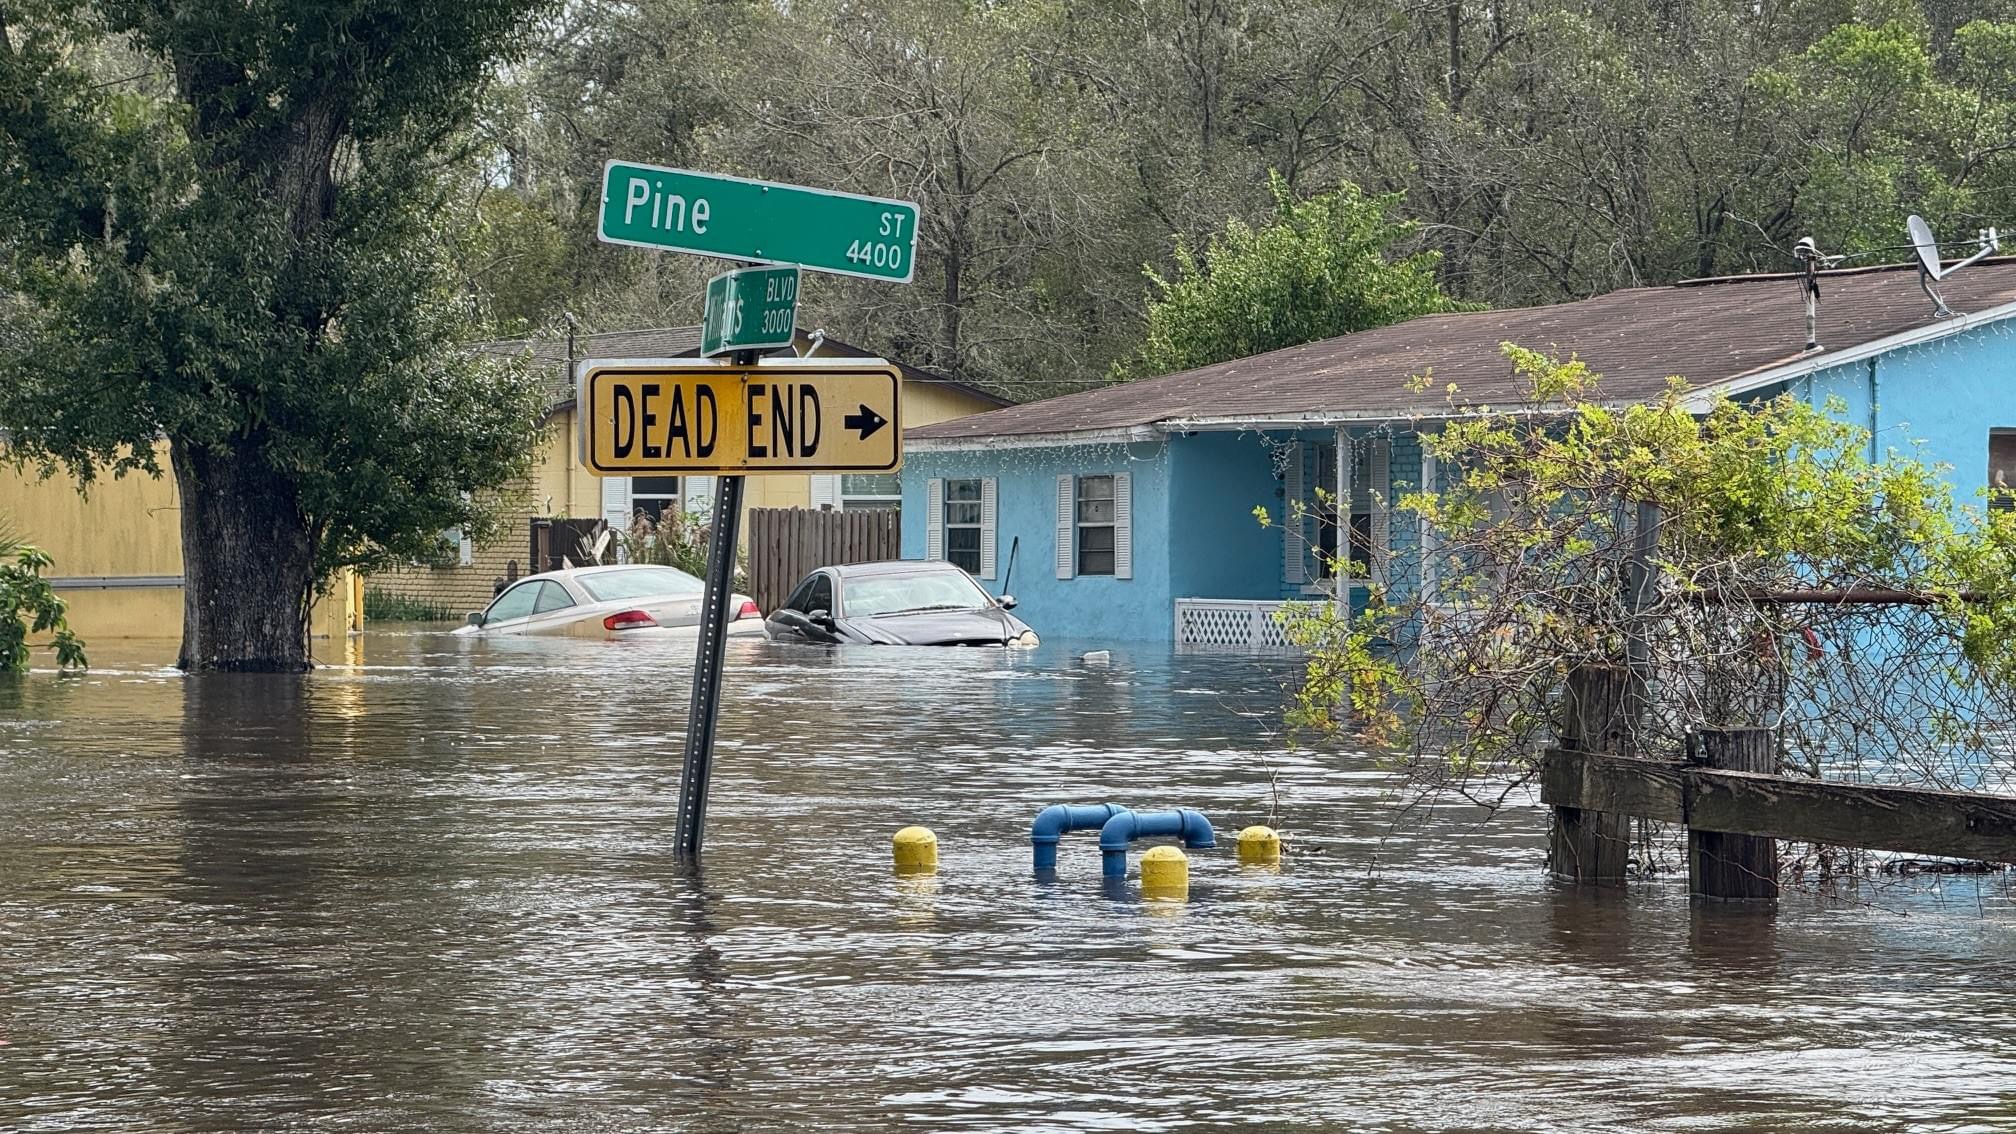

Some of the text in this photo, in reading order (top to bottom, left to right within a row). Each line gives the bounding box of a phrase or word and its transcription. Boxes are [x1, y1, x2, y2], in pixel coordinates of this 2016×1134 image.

[624, 177, 906, 238] Pine ST
[846, 239, 902, 270] 4400
[766, 276, 795, 302] BLVD
[761, 308, 791, 335] 3000
[613, 383, 822, 459] DEAD END
